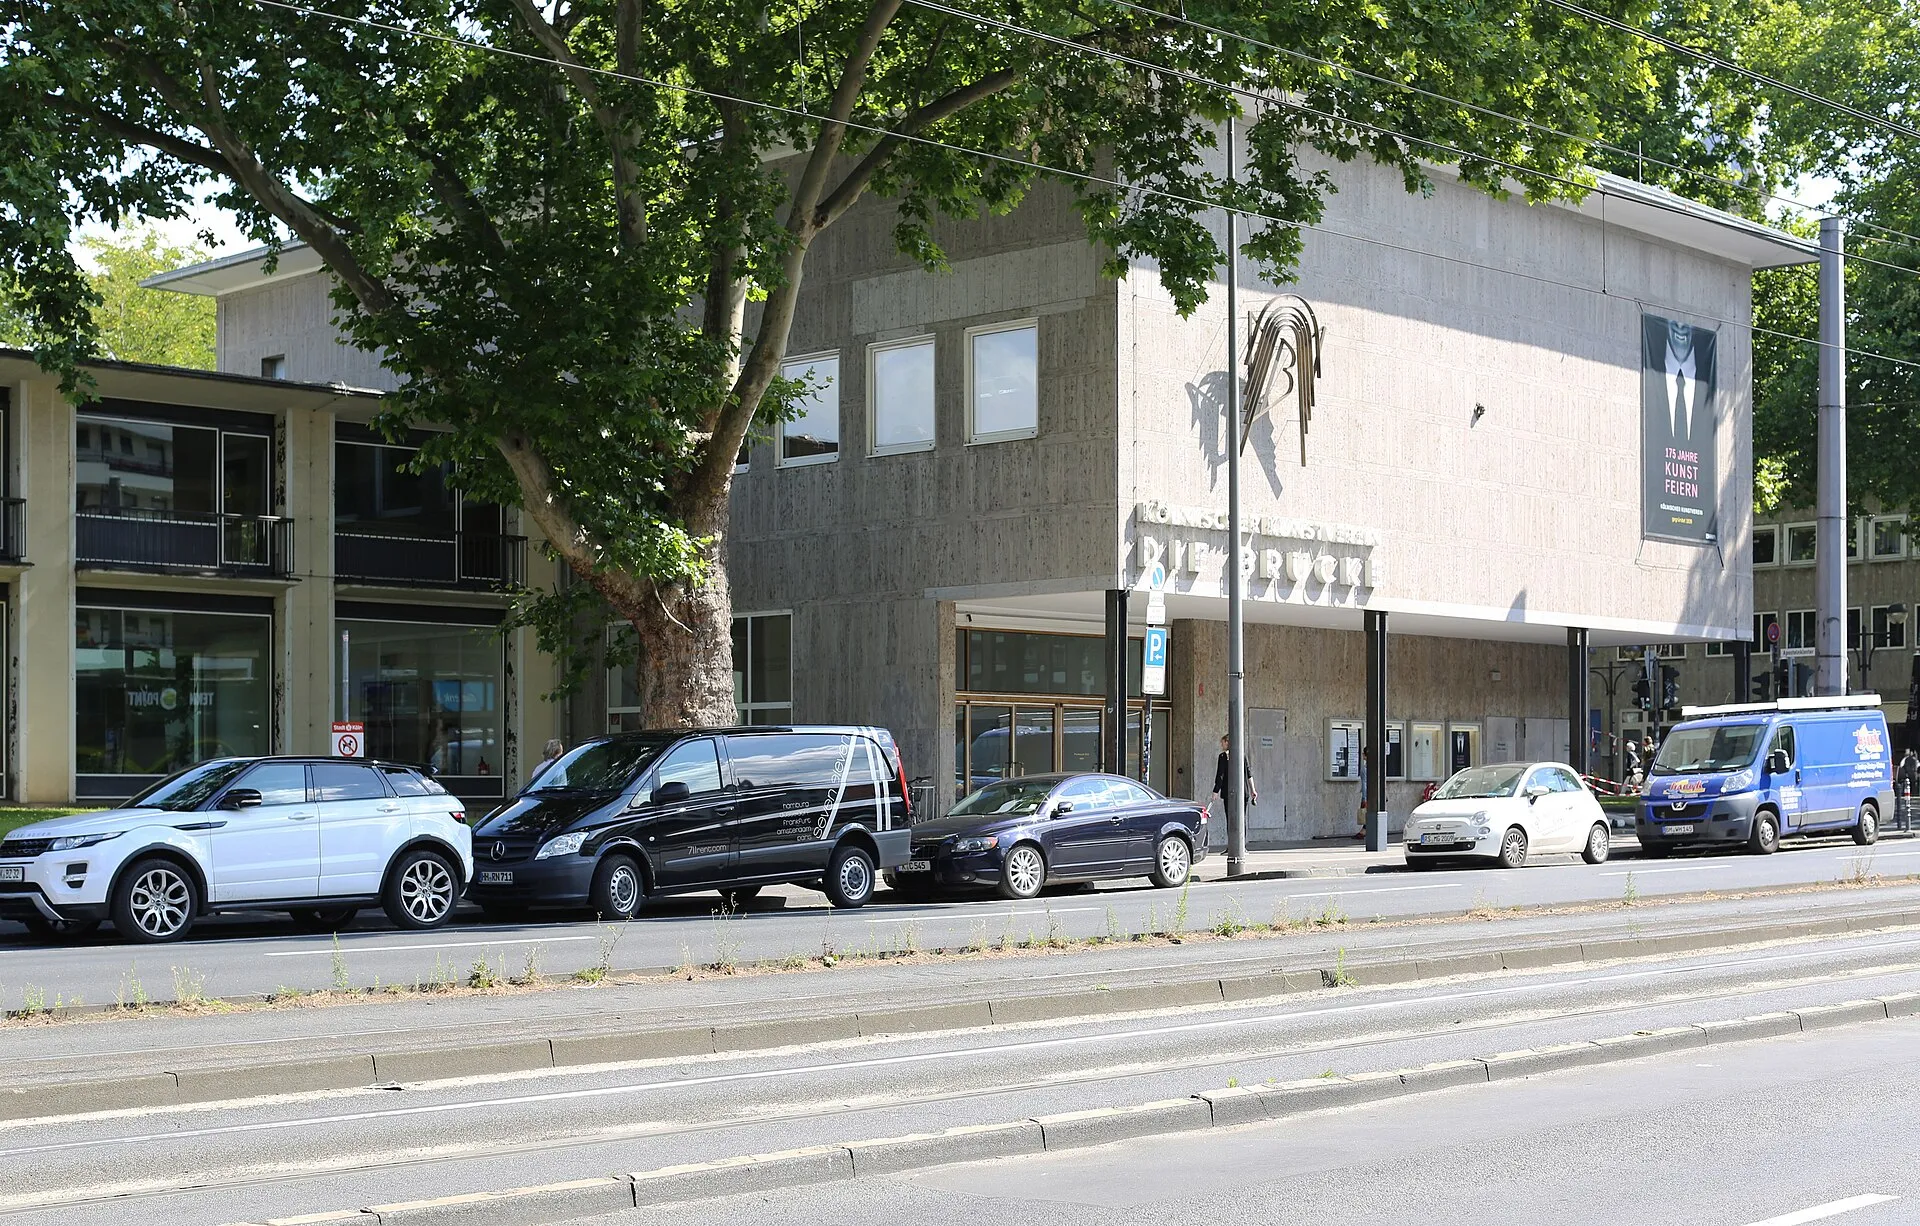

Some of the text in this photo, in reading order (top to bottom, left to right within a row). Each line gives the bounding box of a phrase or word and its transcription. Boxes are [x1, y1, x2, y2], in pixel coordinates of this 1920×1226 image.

[1665, 447, 1698, 463] 175 JAHRE
[1665, 461, 1698, 480] KUNST
[1665, 479, 1698, 498] FEIERN
[1137, 536, 1210, 573] DIE
[1149, 633, 1162, 662] P
[812, 788, 838, 839] seven
